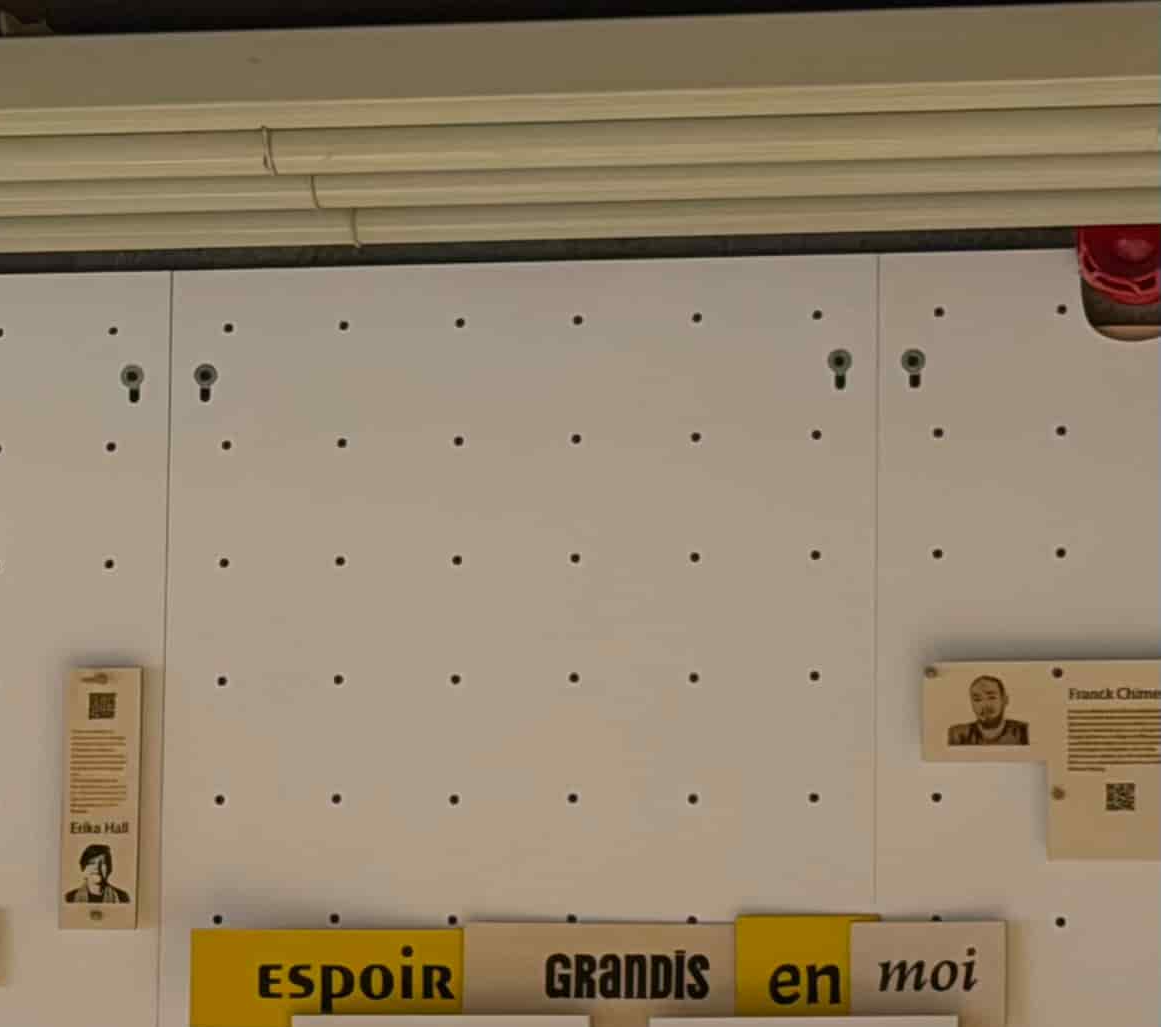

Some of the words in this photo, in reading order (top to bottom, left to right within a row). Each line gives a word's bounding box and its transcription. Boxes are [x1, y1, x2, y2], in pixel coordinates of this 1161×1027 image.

[1069, 687, 1114, 700] Franck
[70, 821, 101, 834] Erika
[104, 821, 129, 834] Hall
[878, 946, 979, 992] moi
[768, 963, 842, 1005] en
